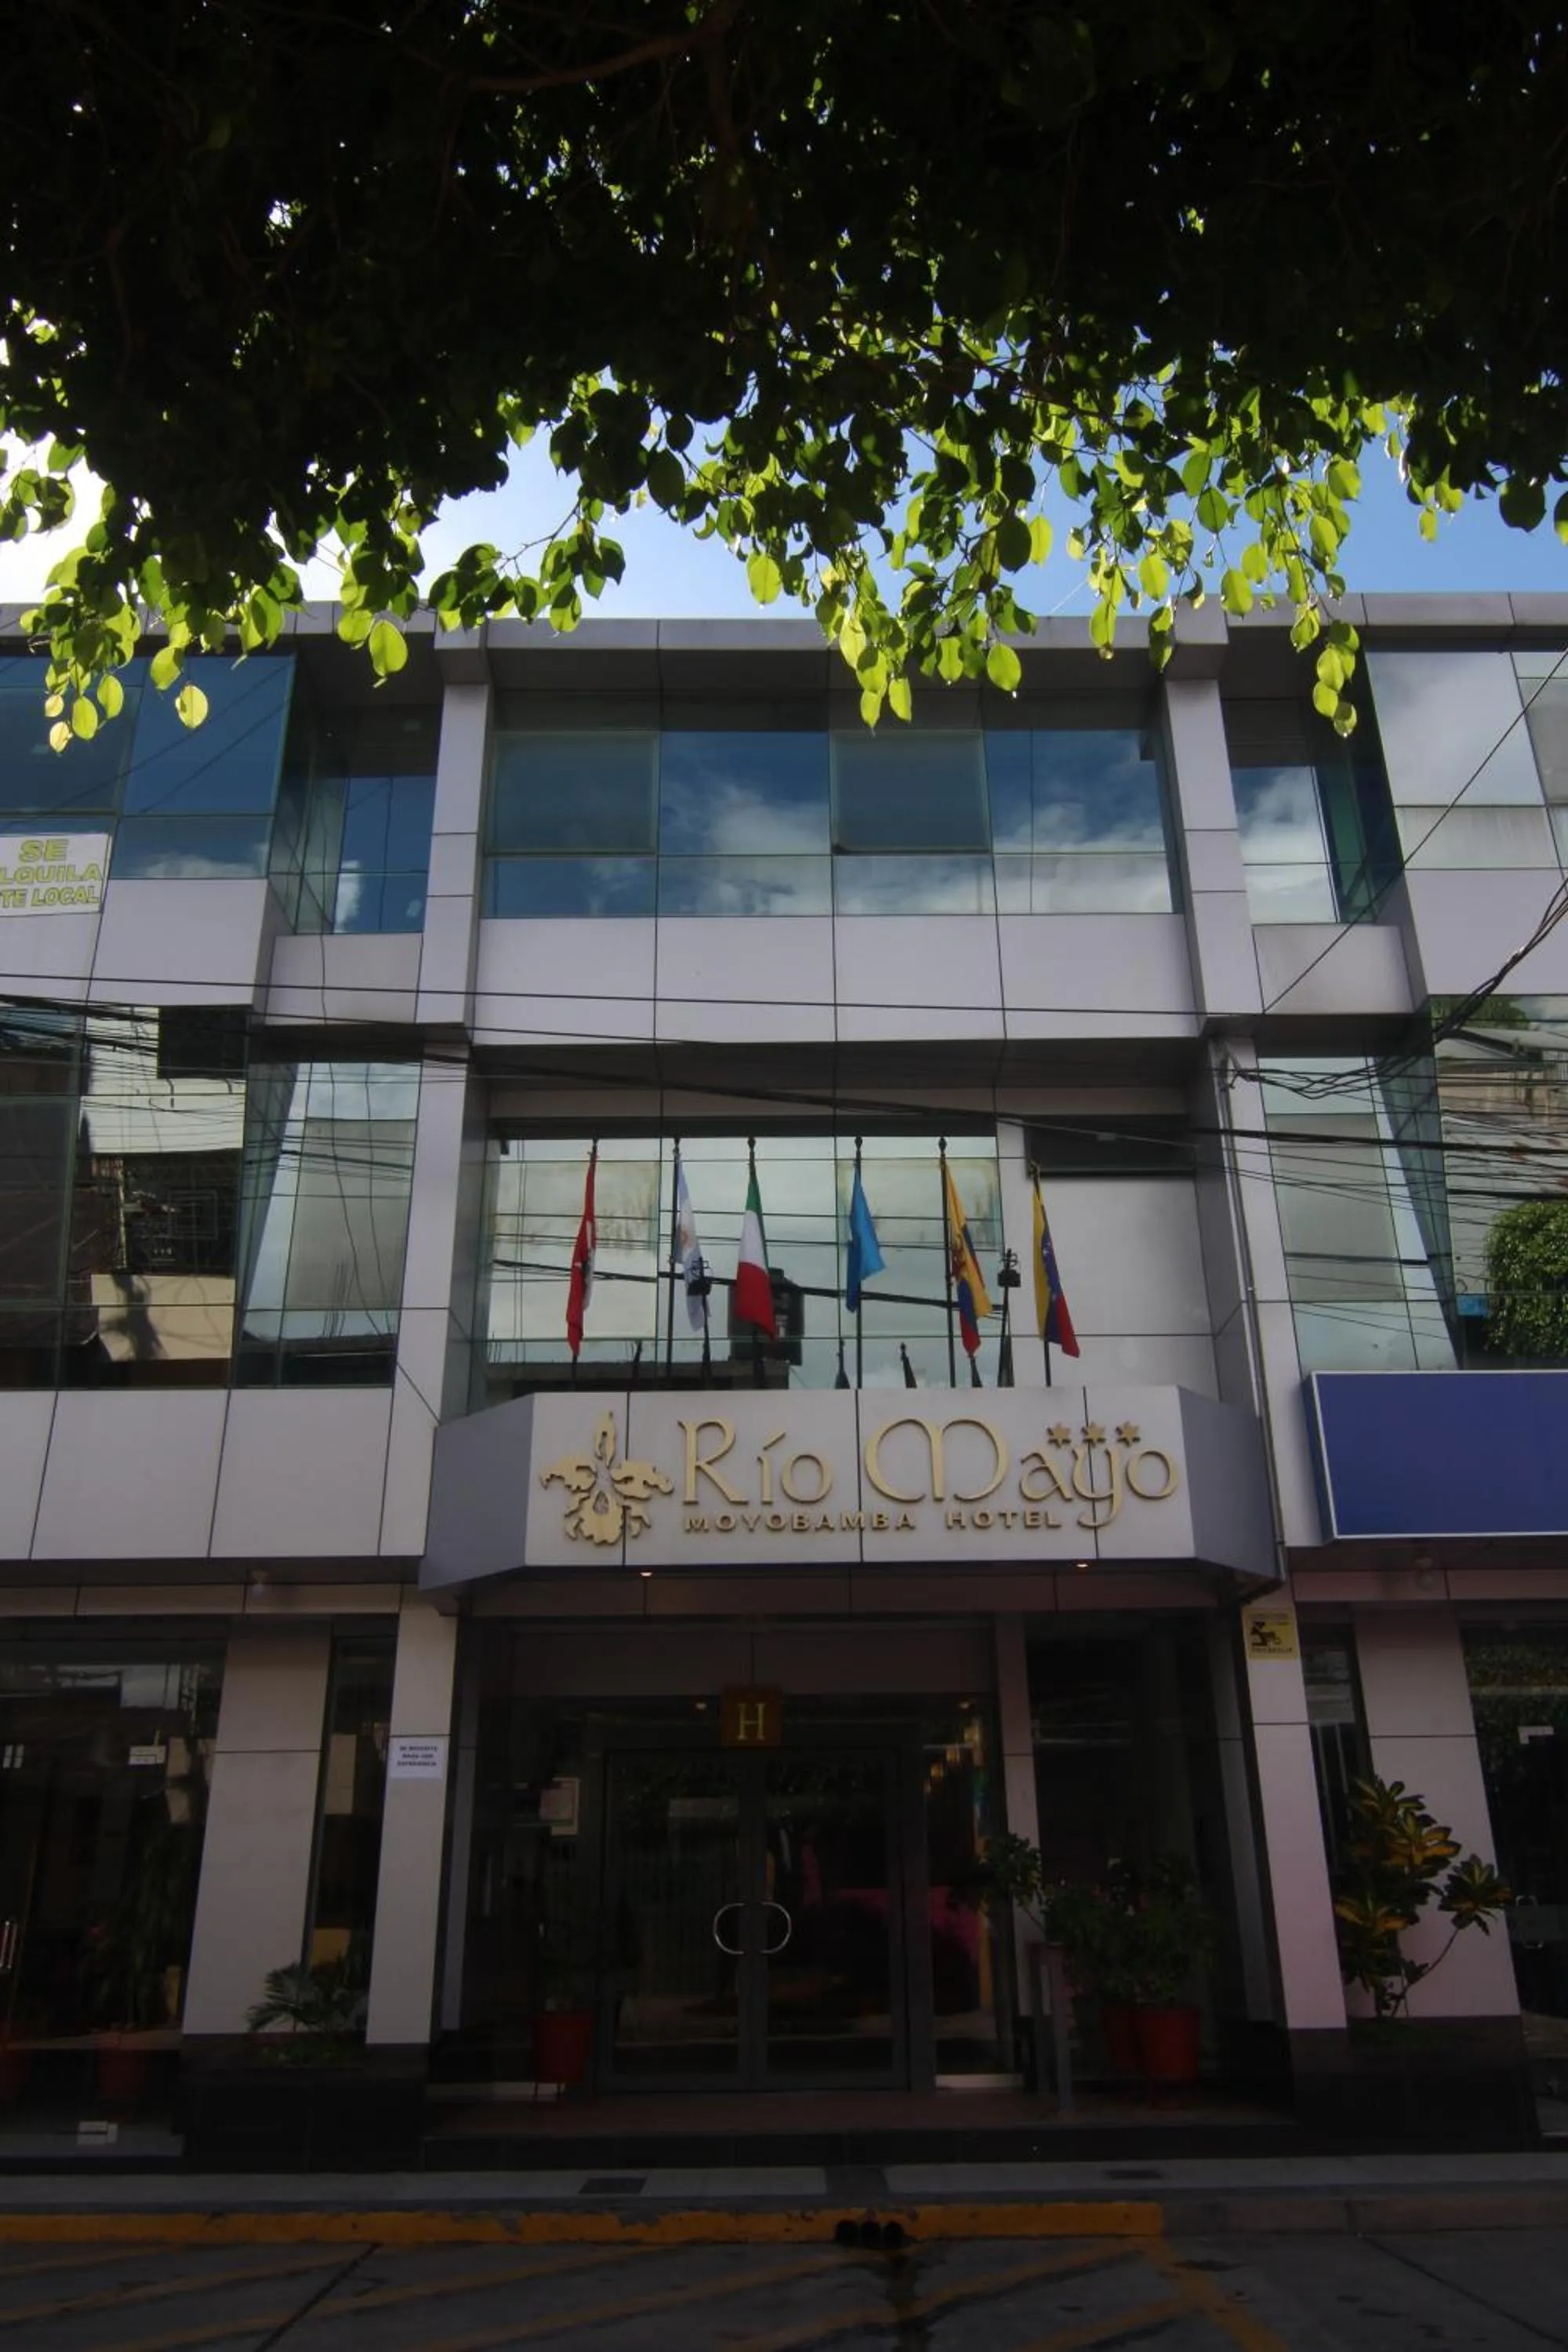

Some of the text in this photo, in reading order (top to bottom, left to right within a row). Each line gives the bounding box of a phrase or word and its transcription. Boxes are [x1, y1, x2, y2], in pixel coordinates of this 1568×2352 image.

[19, 839, 68, 862] SE
[31, 886, 100, 906] LOCAL
[677, 1417, 1177, 1529] Río Mayo
[684, 1508, 1062, 1533] MOYOBAMBA HOTEL
[736, 1702, 765, 1740] H
